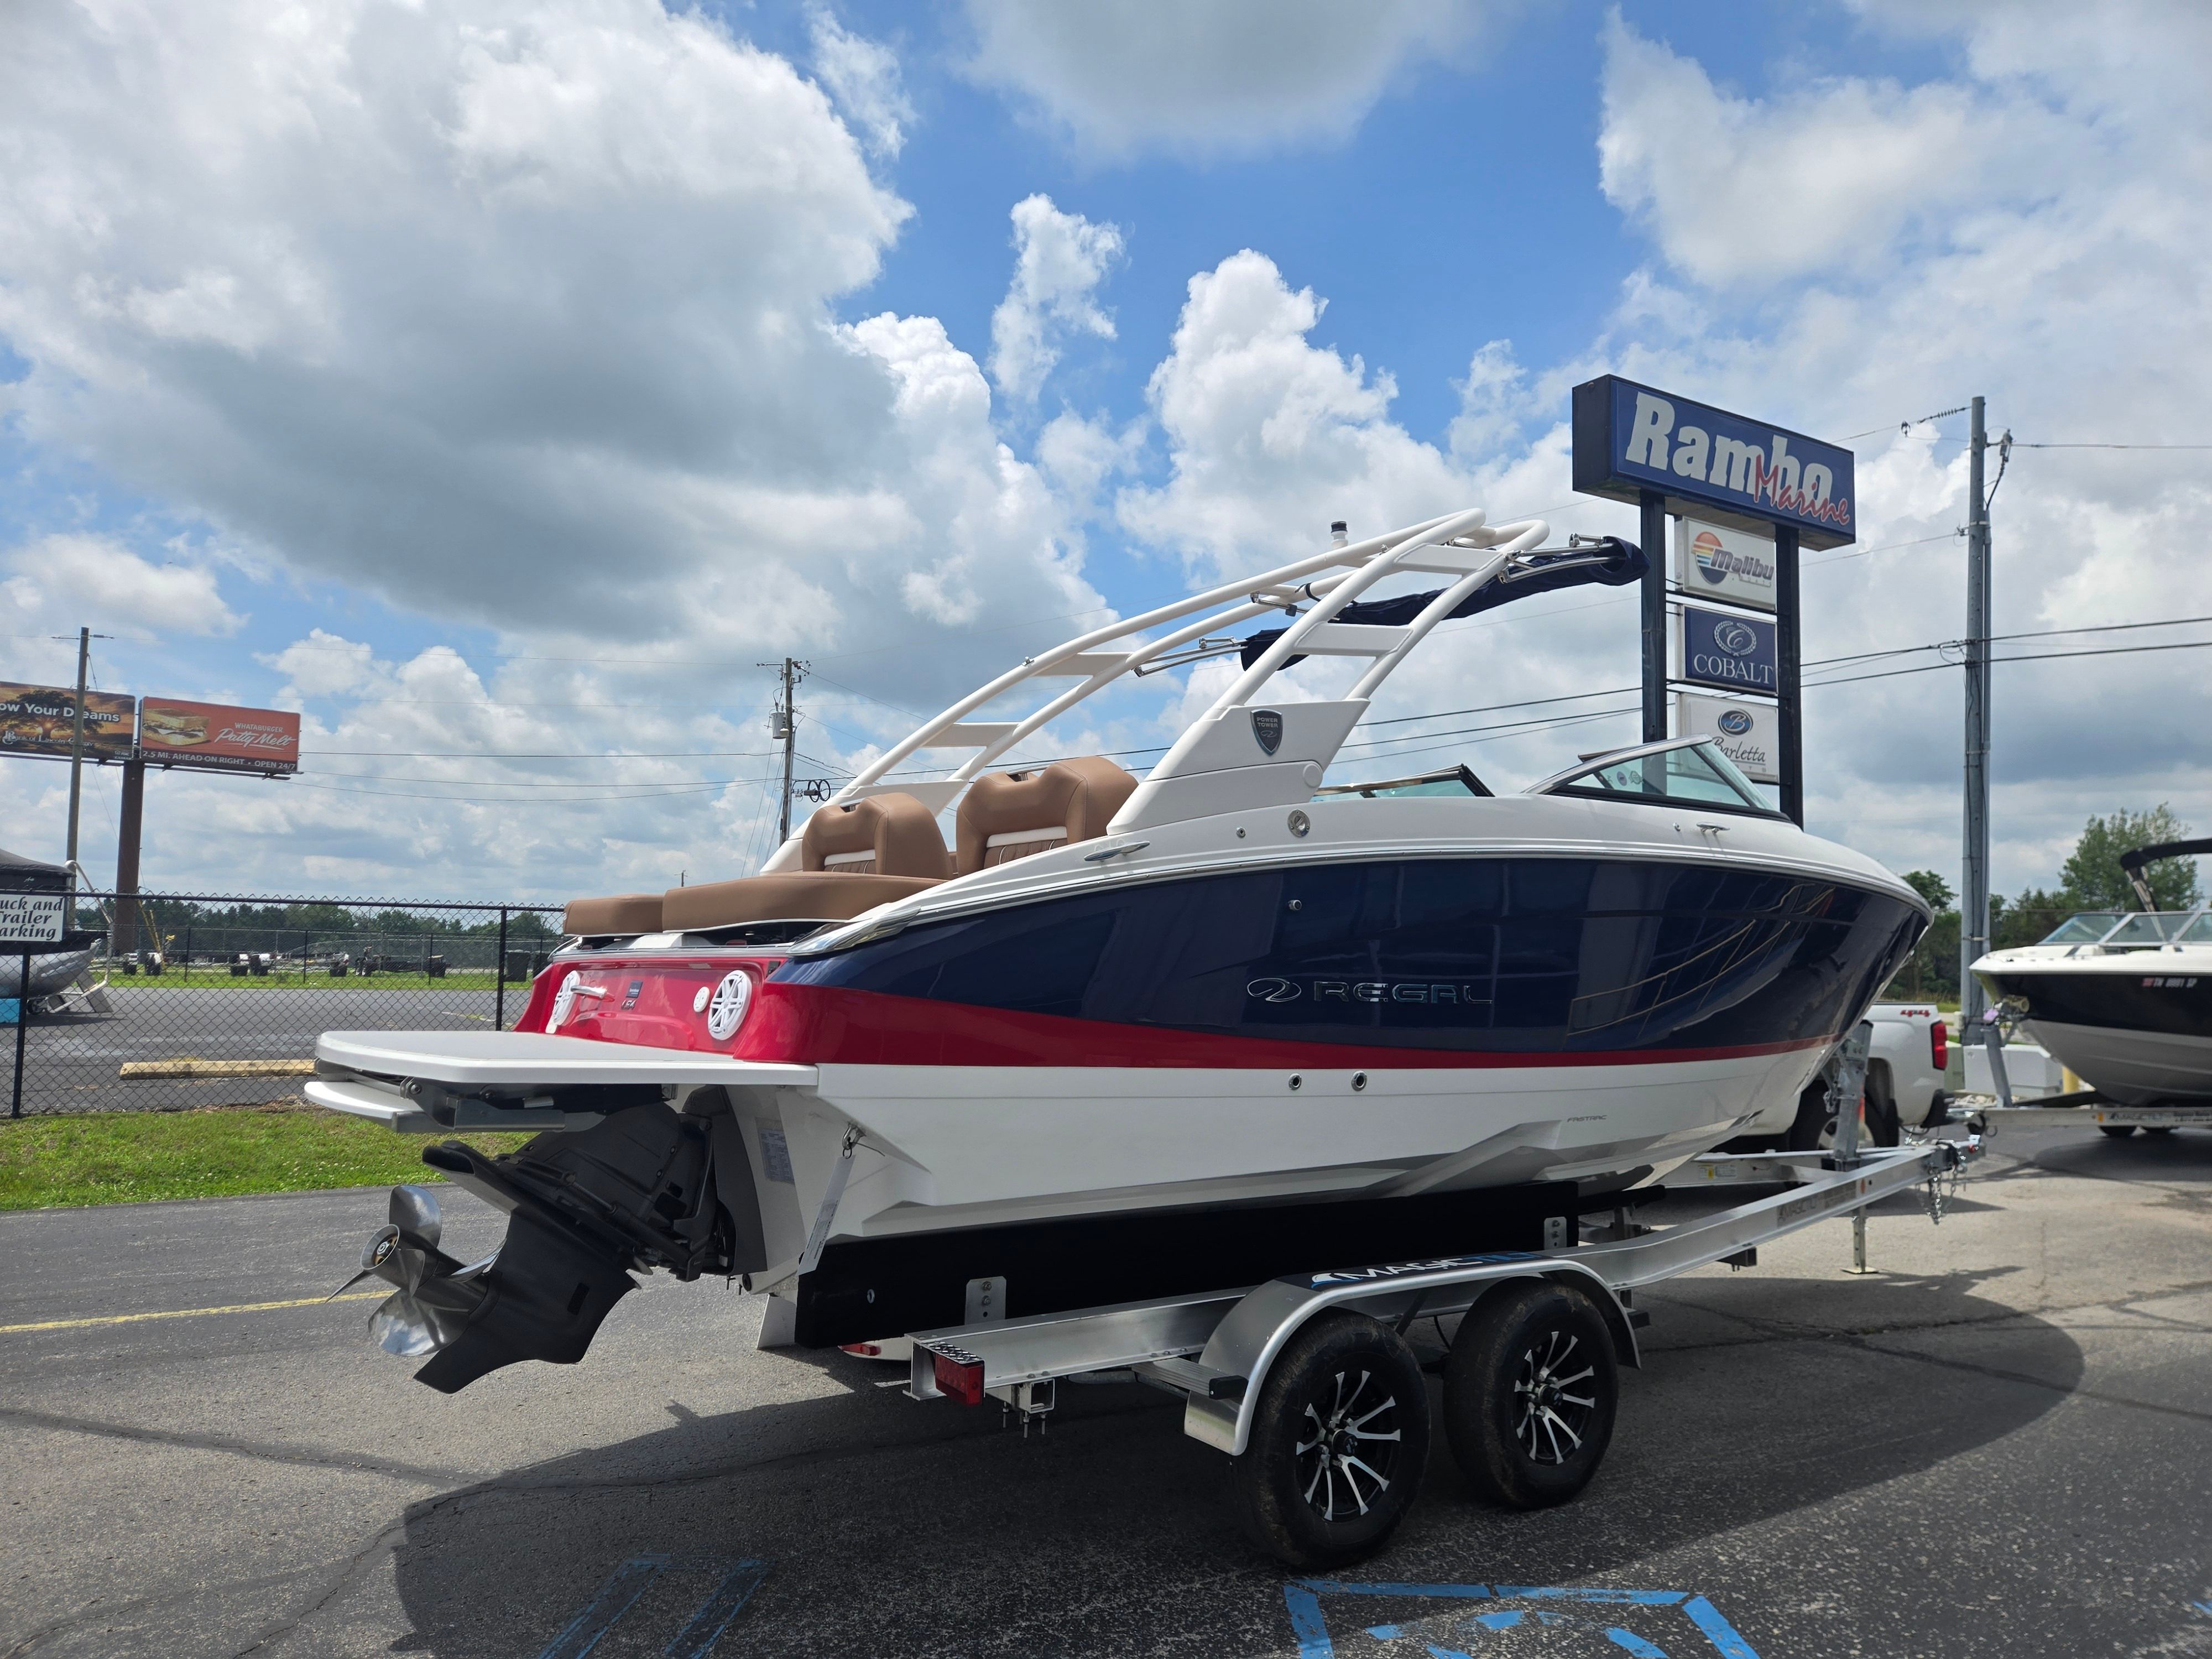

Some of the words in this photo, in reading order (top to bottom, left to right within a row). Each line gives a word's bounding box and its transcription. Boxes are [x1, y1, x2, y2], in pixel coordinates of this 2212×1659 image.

[1625, 391, 1833, 503] Rambo
[1754, 453, 1850, 525] Marine
[1710, 548, 1775, 580] Malibu
[1693, 654, 1773, 684] COBALT
[24, 703, 59, 716] Your
[63, 707, 120, 722] Deams
[214, 728, 259, 748] Patty
[253, 733, 297, 746] Melt
[234, 722, 284, 733] WHATABURGER
[1712, 736, 1766, 762] Barletta
[172, 753, 203, 761] AHEAD
[204, 755, 218, 764] ON
[220, 757, 245, 765] RIGHT
[254, 760, 277, 769] OPEN
[278, 762, 296, 770] 24/7
[33, 896, 65, 911] and
[1313, 980, 1494, 1004] REGAL
[1567, 1114, 1608, 1123] FASTRAC
